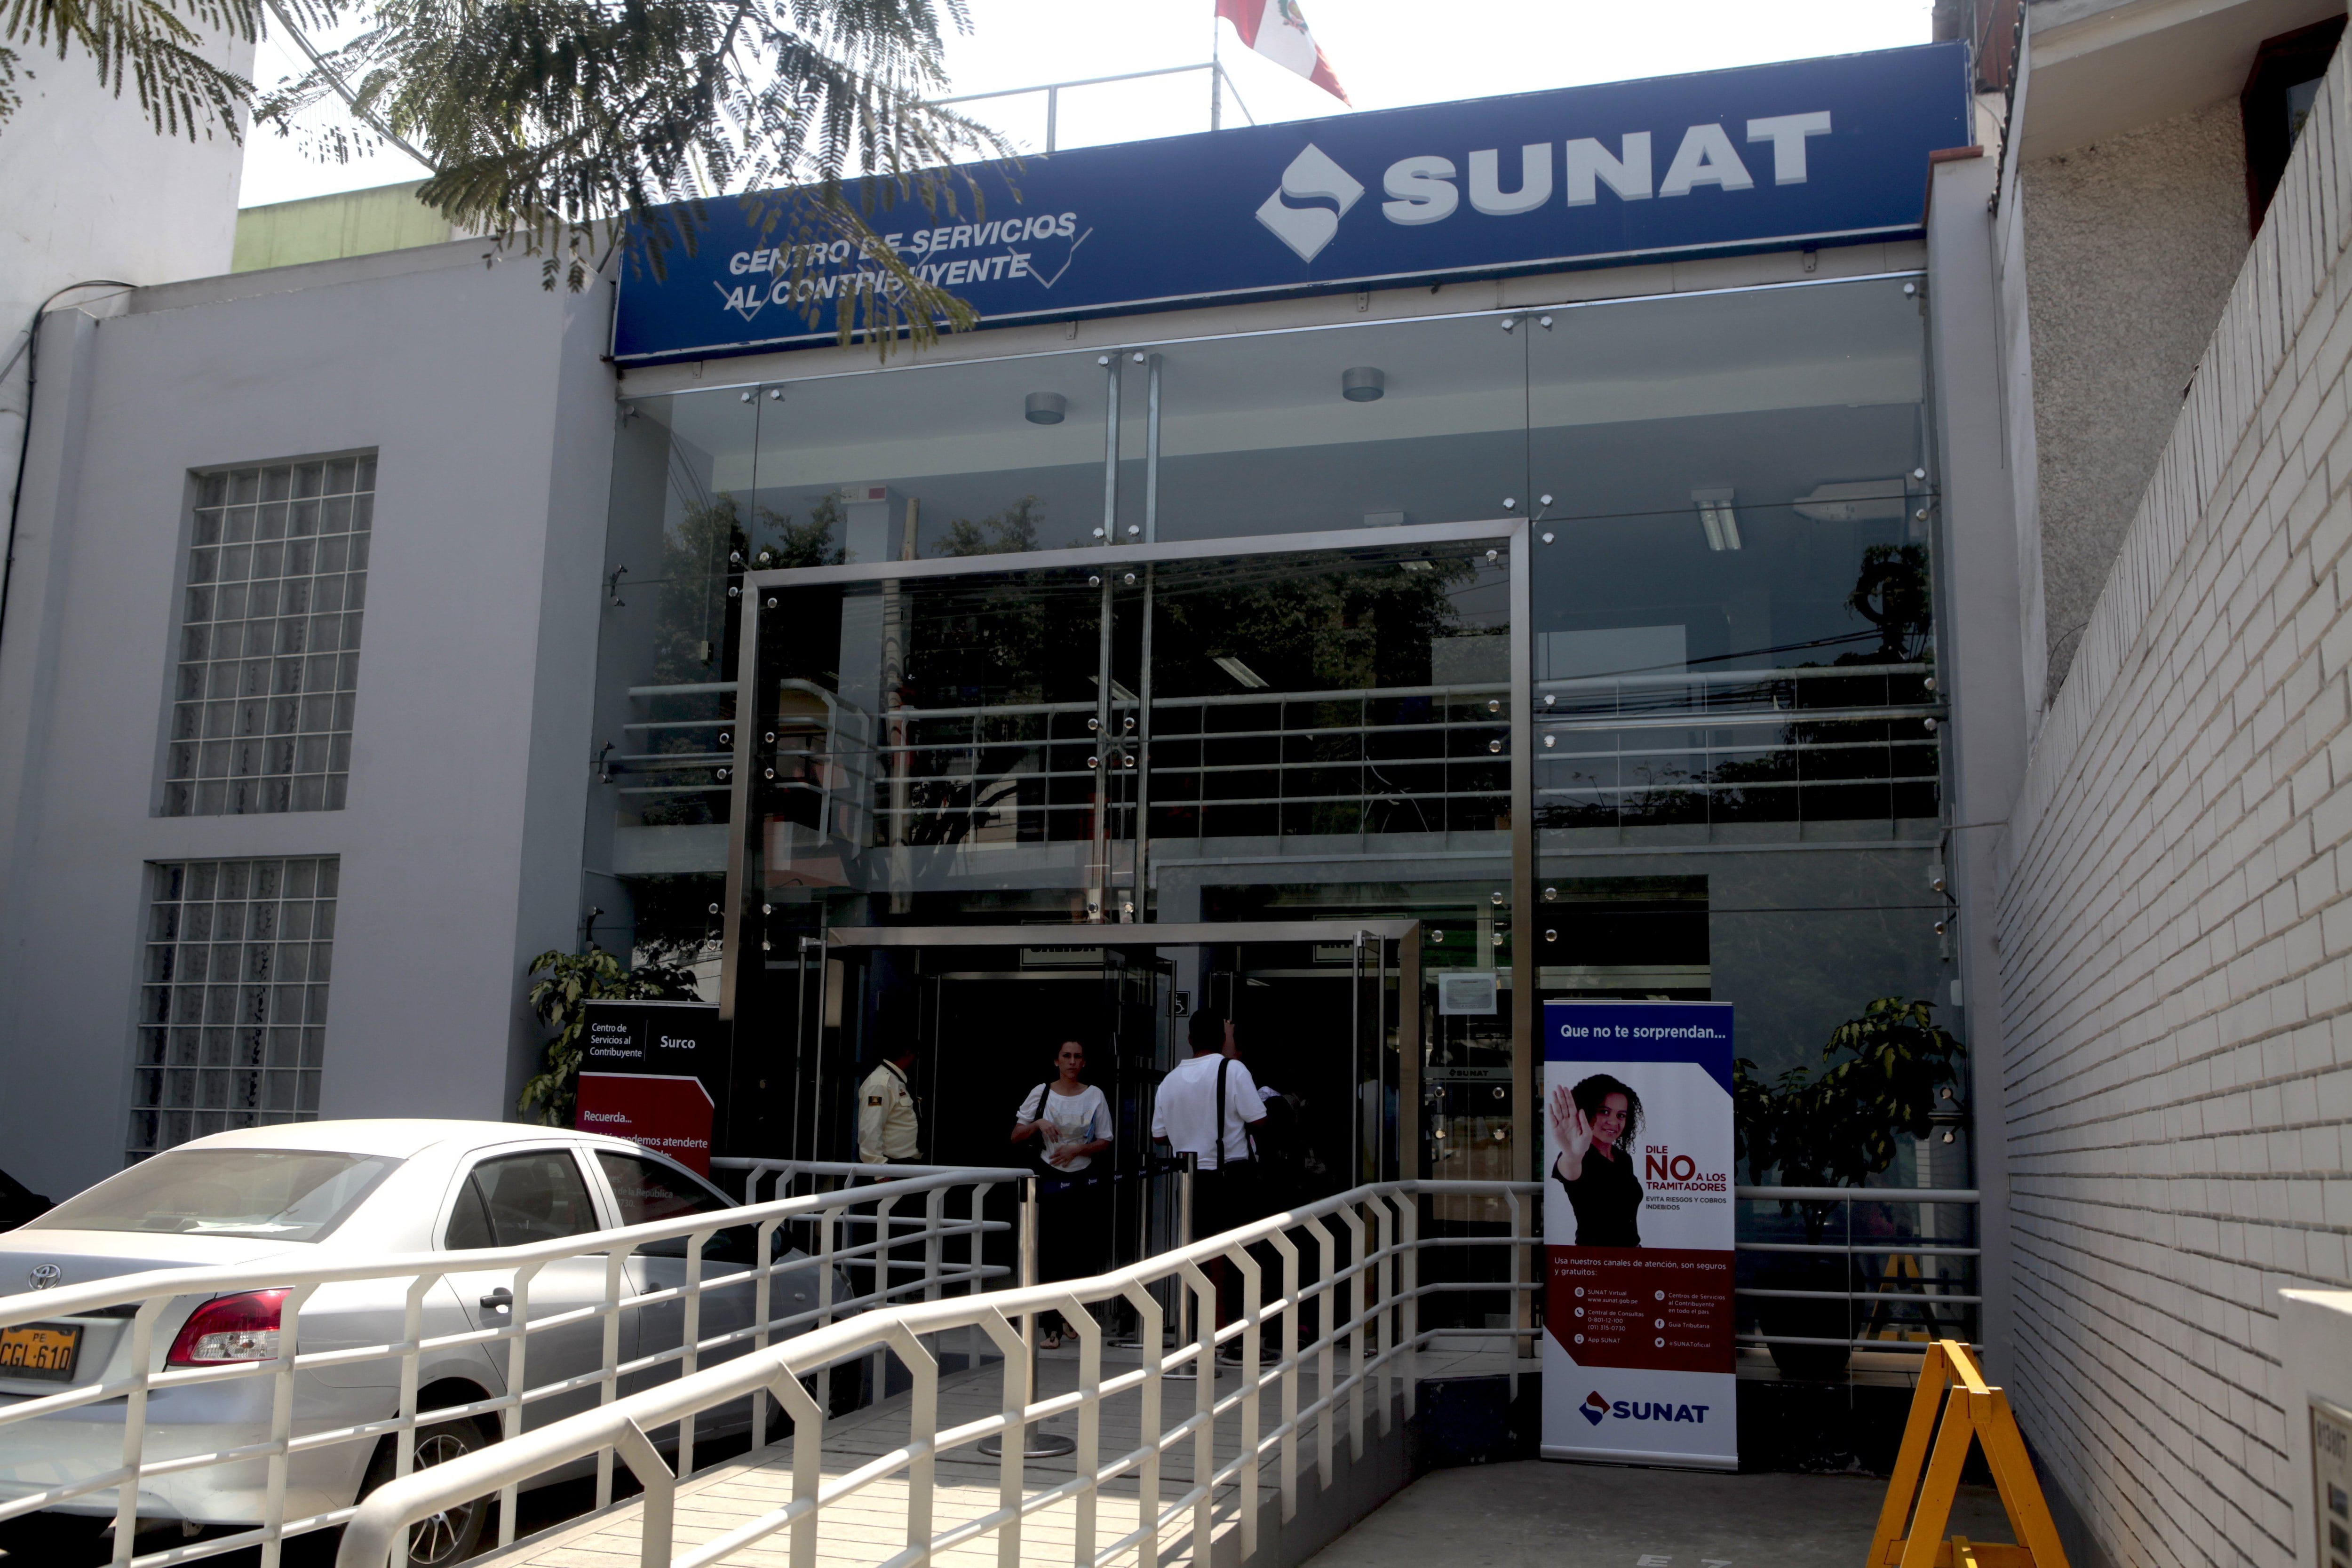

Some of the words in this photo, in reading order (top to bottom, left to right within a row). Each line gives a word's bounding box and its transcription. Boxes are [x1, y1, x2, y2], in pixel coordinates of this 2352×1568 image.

[1382, 111, 1831, 225] SUNAT
[910, 212, 1077, 253] SERVICIOS
[723, 285, 762, 310] AL
[592, 1023, 616, 1032] Centro
[617, 1024, 627, 1032] de
[1561, 1025, 1589, 1037] Que
[1594, 1027, 1611, 1037] no
[1615, 1026, 1629, 1037] te
[1633, 1026, 1726, 1040] sorprendan...
[591, 1035, 622, 1044] Servicios
[624, 1036, 631, 1044] al
[660, 1036, 696, 1049] Surco
[589, 1047, 642, 1059] Contribuyente
[584, 1110, 632, 1123] Recuerda...
[663, 1137, 707, 1148] atenderte
[1646, 1155, 1696, 1181] NO
[1707, 1173, 1726, 1182] LOS
[1646, 1182, 1726, 1192] TRAMITADORES
[1645, 1260, 1679, 1269] atención,
[1696, 1262, 1726, 1271] seguros
[1561, 1268, 1597, 1277] gratuitos:
[32, 1333, 47, 1342] PE
[1613, 1401, 1709, 1423] SUNAT
